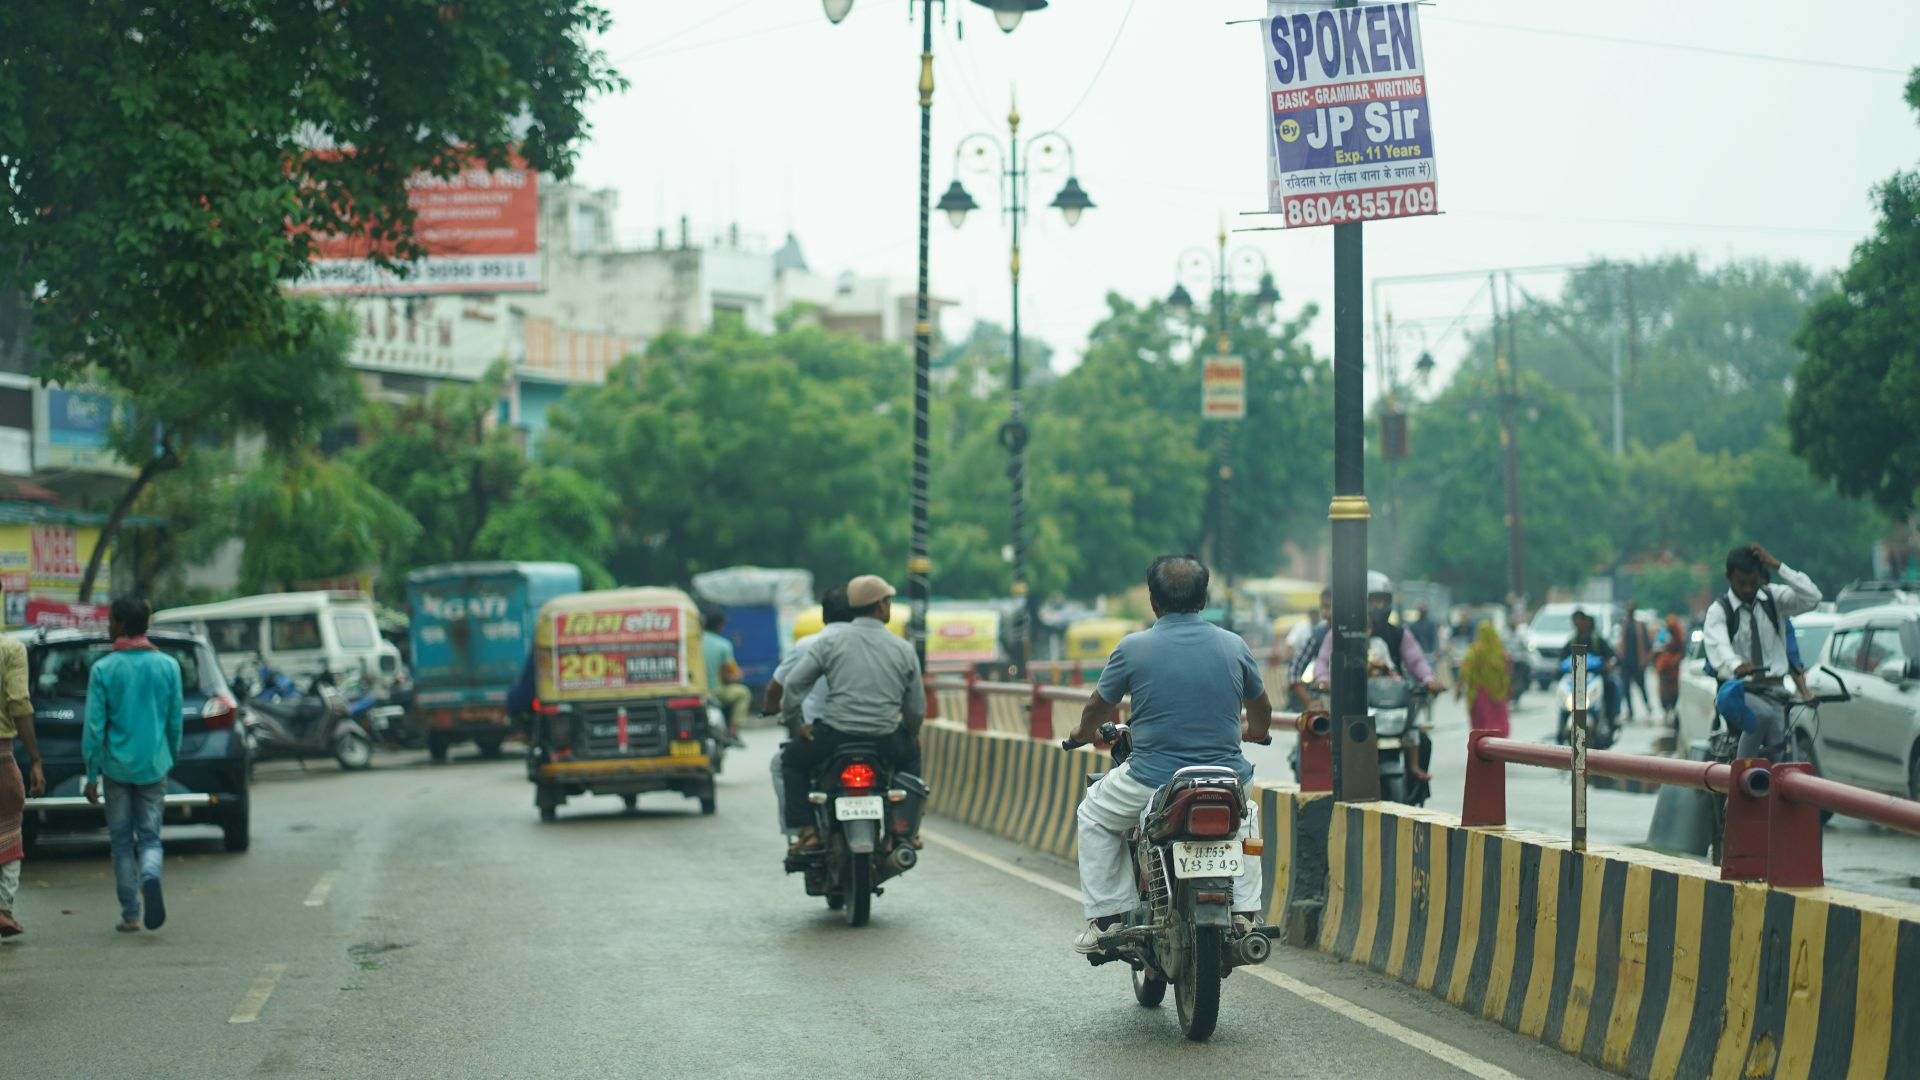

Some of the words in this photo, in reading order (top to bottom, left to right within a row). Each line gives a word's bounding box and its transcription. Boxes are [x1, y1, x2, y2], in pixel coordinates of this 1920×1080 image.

[1270, 3, 1417, 85] SPOKEN
[1282, 124, 1298, 138] By
[1307, 107, 1353, 149] JP
[1365, 101, 1419, 143] Sir
[1336, 149, 1364, 165] Exp.
[1366, 146, 1382, 160] 11
[1384, 144, 1421, 158] Years
[1285, 173, 1316, 189] रविदास
[1319, 171, 1332, 186] गेट
[1383, 165, 1392, 179] के
[1287, 187, 1434, 226] 8604355709
